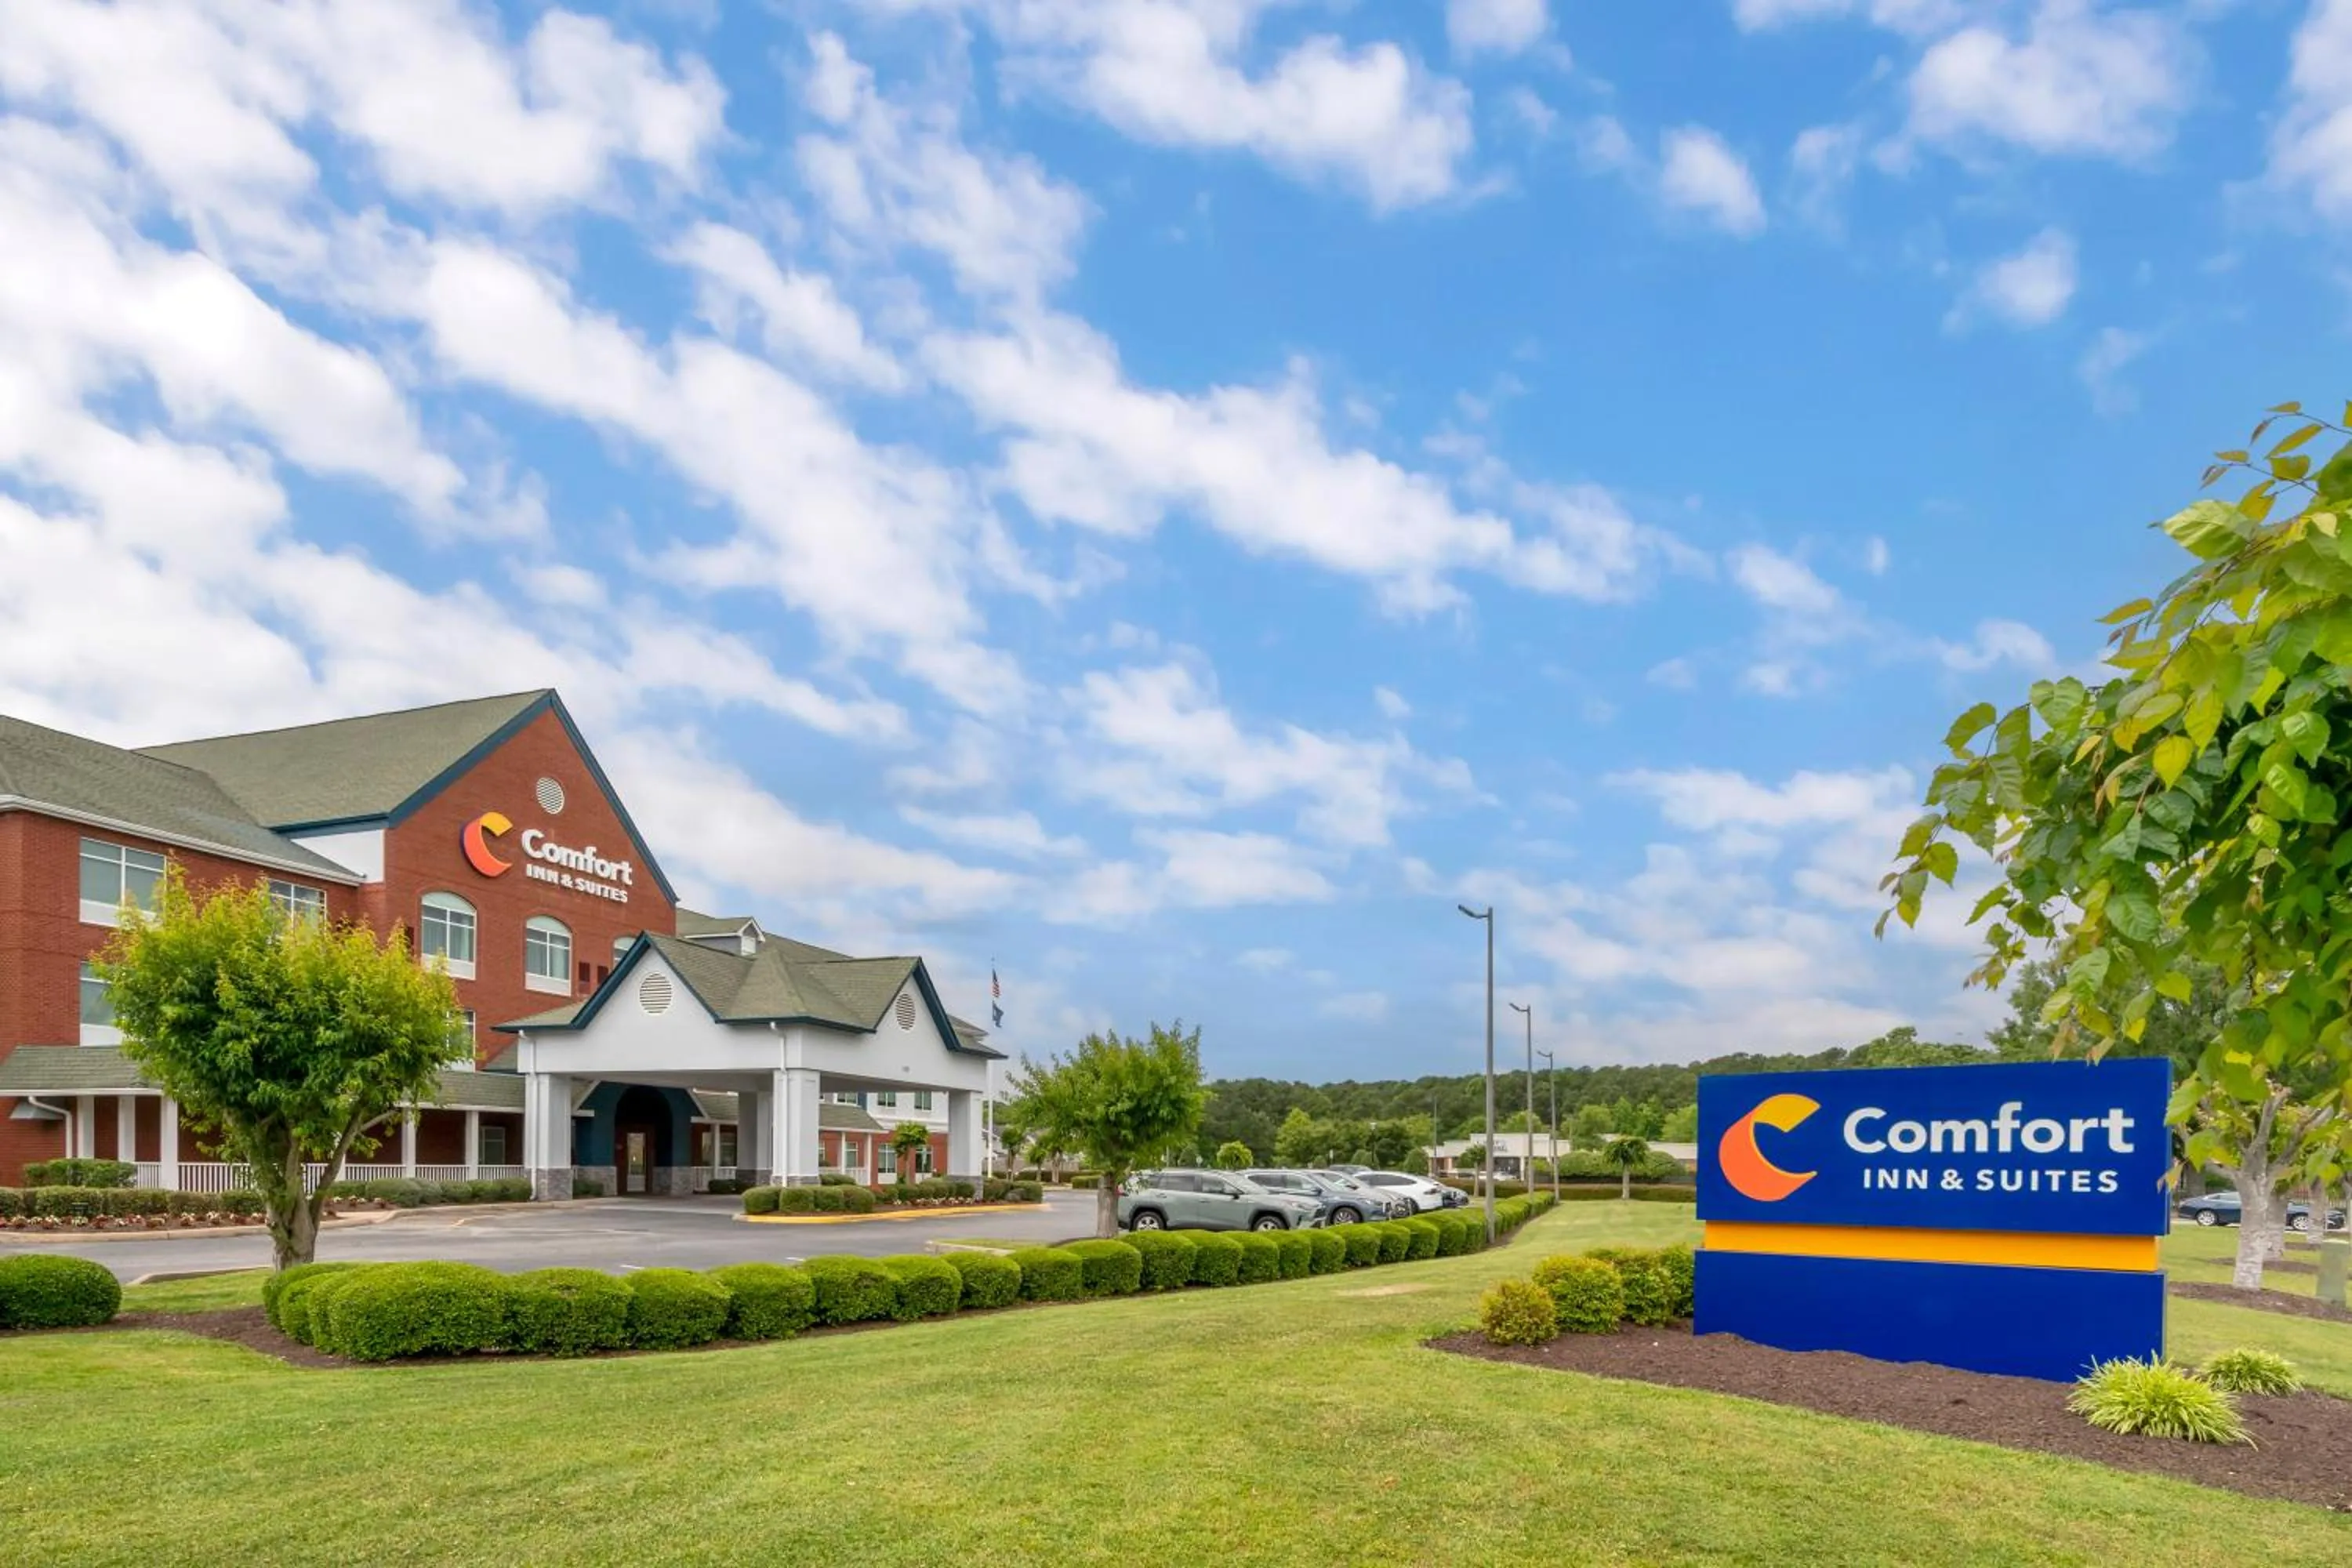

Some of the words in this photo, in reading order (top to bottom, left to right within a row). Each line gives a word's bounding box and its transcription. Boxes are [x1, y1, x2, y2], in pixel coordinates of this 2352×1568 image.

[521, 829, 633, 885] Comfort
[526, 863, 558, 884] INN
[560, 874, 573, 888] &
[575, 877, 627, 903] SUITES
[1843, 1102, 2135, 1153] Comfort
[1864, 1168, 1928, 1189] INN
[1940, 1168, 1964, 1190] &
[1976, 1169, 2118, 1193] SUITES
